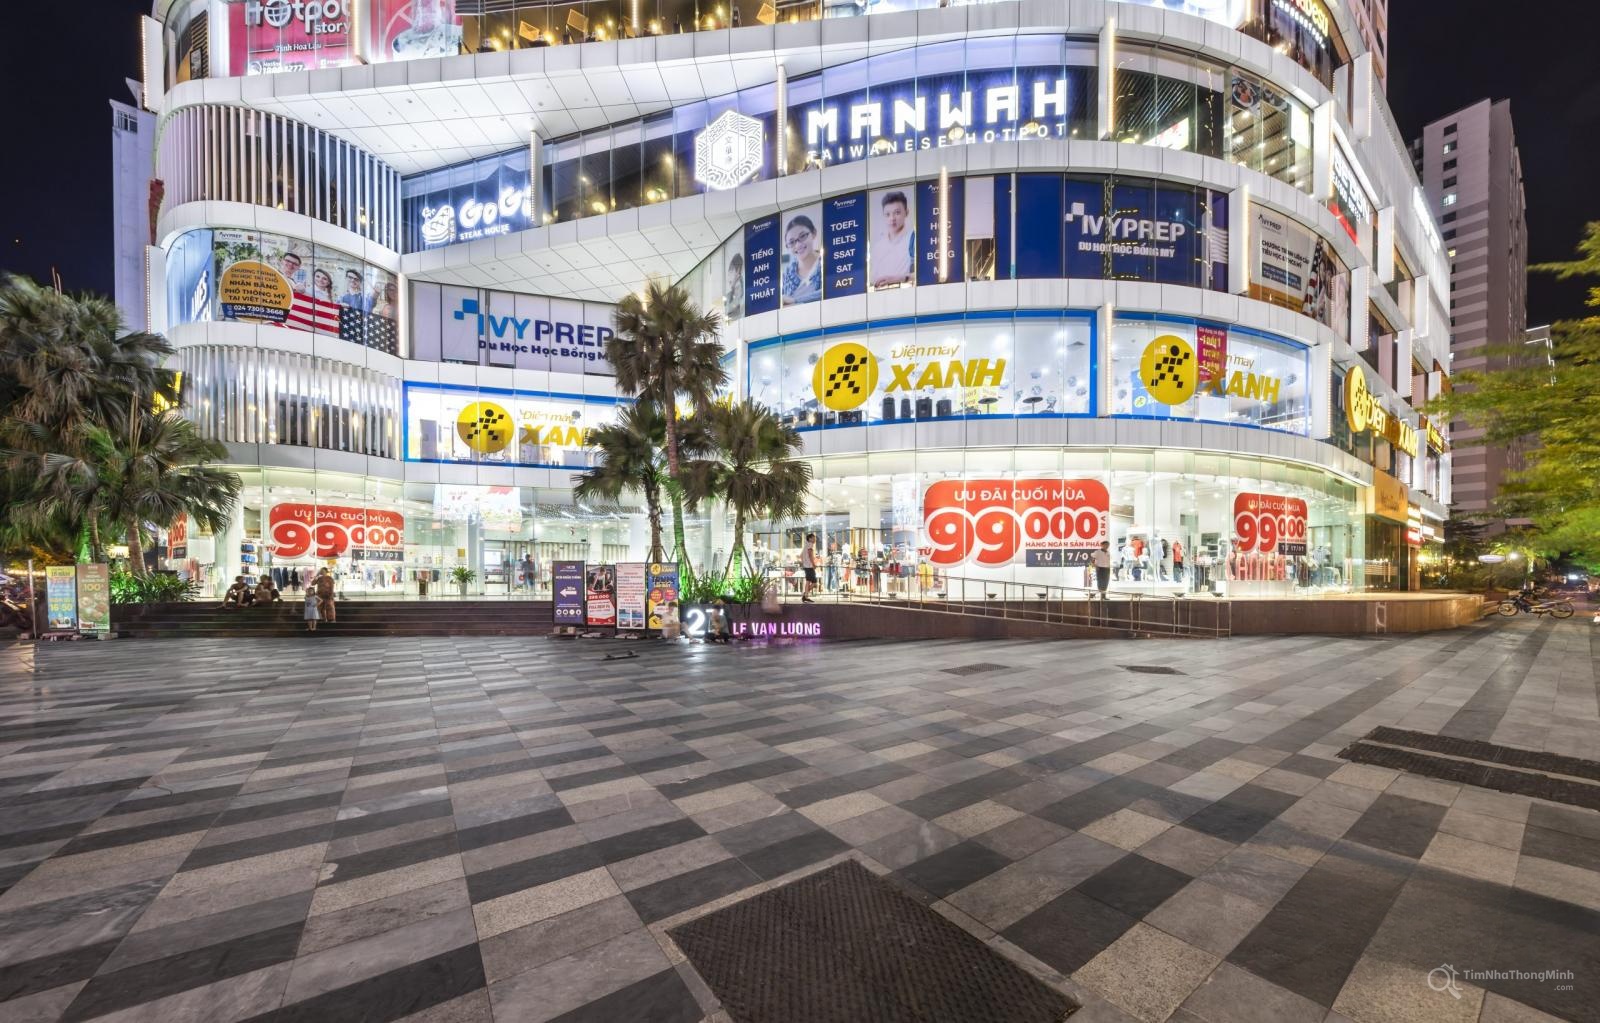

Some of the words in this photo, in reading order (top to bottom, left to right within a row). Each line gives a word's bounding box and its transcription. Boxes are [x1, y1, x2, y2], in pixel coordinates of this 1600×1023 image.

[807, 79, 1067, 145] MANWAH
[808, 135, 947, 161] TAIWANESE
[966, 123, 1066, 143] HOTPOT
[830, 219, 859, 232] TOEFL
[930, 221, 952, 230] HC
[1081, 214, 1186, 242] IVYPREP
[460, 230, 482, 240] STEAK
[485, 224, 510, 237] HOUSE
[833, 234, 857, 245] IELTS
[930, 236, 952, 245] HC
[1078, 241, 1092, 251] DU
[752, 247, 774, 261] TIẾNG
[833, 248, 856, 260] SSAT
[753, 262, 770, 274] ANH
[836, 263, 853, 273] SAT
[753, 276, 770, 288] HỌC
[835, 277, 854, 288] ACT
[242, 289, 272, 297] THÔNG
[750, 287, 776, 301] THUẬT
[262, 298, 282, 306] NAM
[478, 340, 498, 351] Du
[500, 340, 528, 354] Học
[531, 345, 559, 358] Học
[560, 346, 596, 361] Bổng
[884, 358, 1007, 393] XANH
[1204, 369, 1281, 406] XANH
[954, 490, 976, 501] ƯU
[980, 488, 1006, 501] ĐÃI
[1012, 485, 1048, 500] CUỐI
[1052, 487, 1086, 500] MÙA
[1272, 502, 1285, 511] CUỐ
[294, 509, 312, 518] ƯU
[316, 510, 337, 520] ĐÃI
[340, 511, 364, 521] CUỐ
[369, 513, 392, 524] MÙA
[1025, 540, 1046, 548] HÀNG
[1085, 540, 1104, 548] PHẨ
[918, 547, 931, 556] TỪ
[1035, 551, 1054, 561] TỪ
[751, 622, 777, 635] VAN
[780, 621, 821, 635] LUONG
